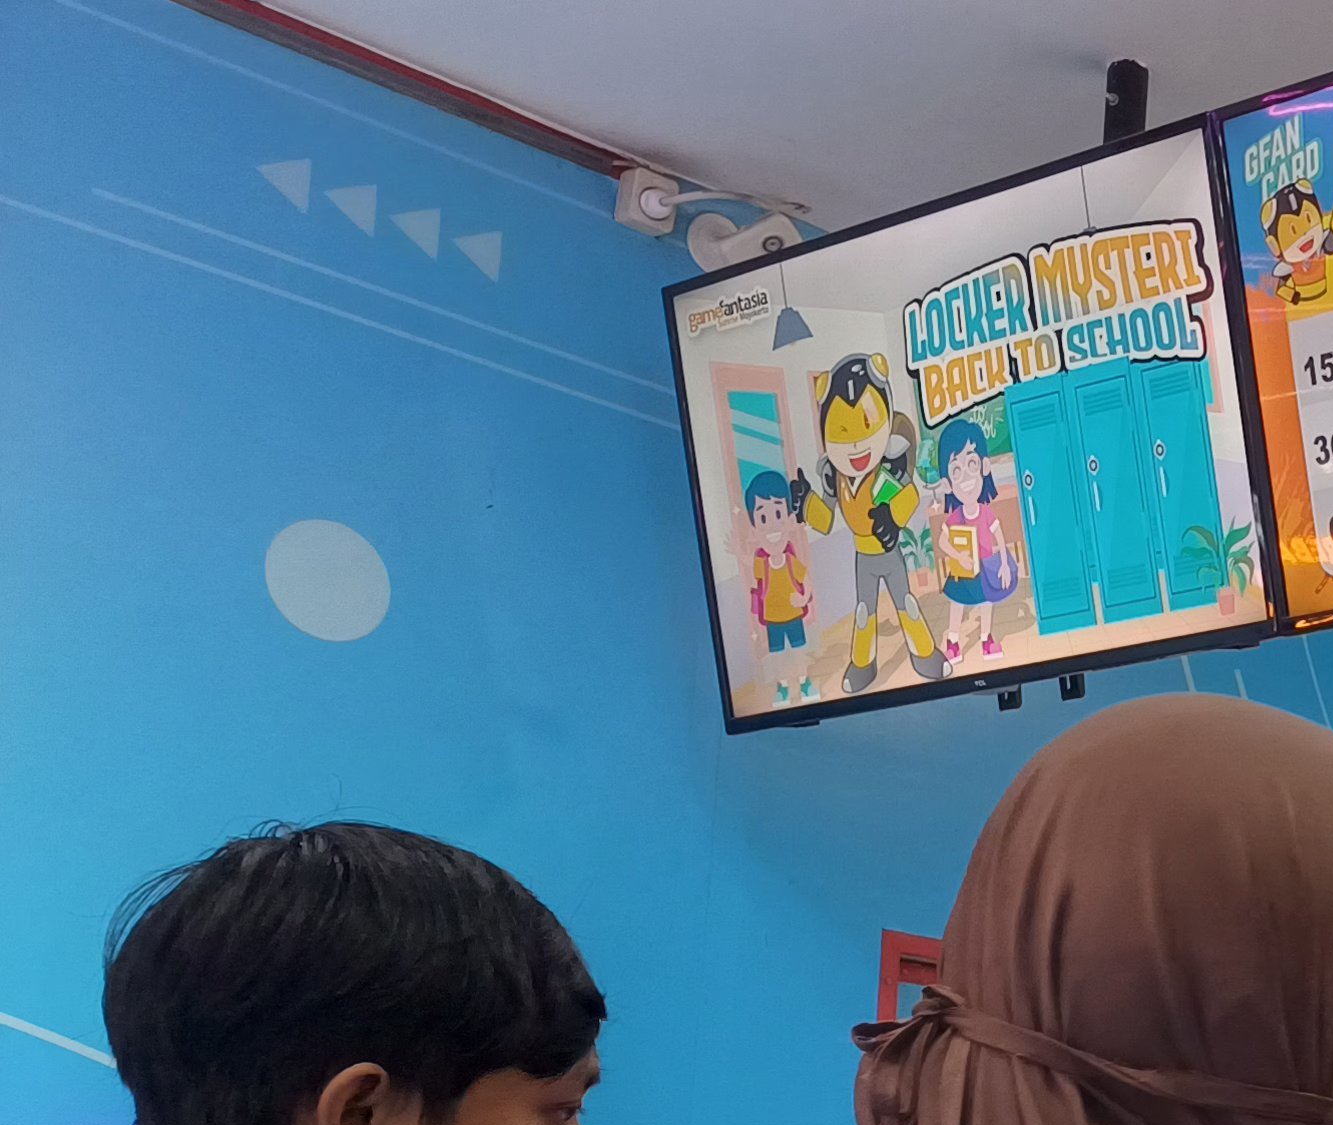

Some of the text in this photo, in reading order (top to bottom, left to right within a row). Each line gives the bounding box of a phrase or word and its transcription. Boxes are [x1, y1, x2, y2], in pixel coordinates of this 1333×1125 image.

[1245, 117, 1301, 180] GFAN
[908, 229, 1201, 363] LOCKER MYSTERI
[923, 297, 1199, 418] BACK TO SCHOOL
